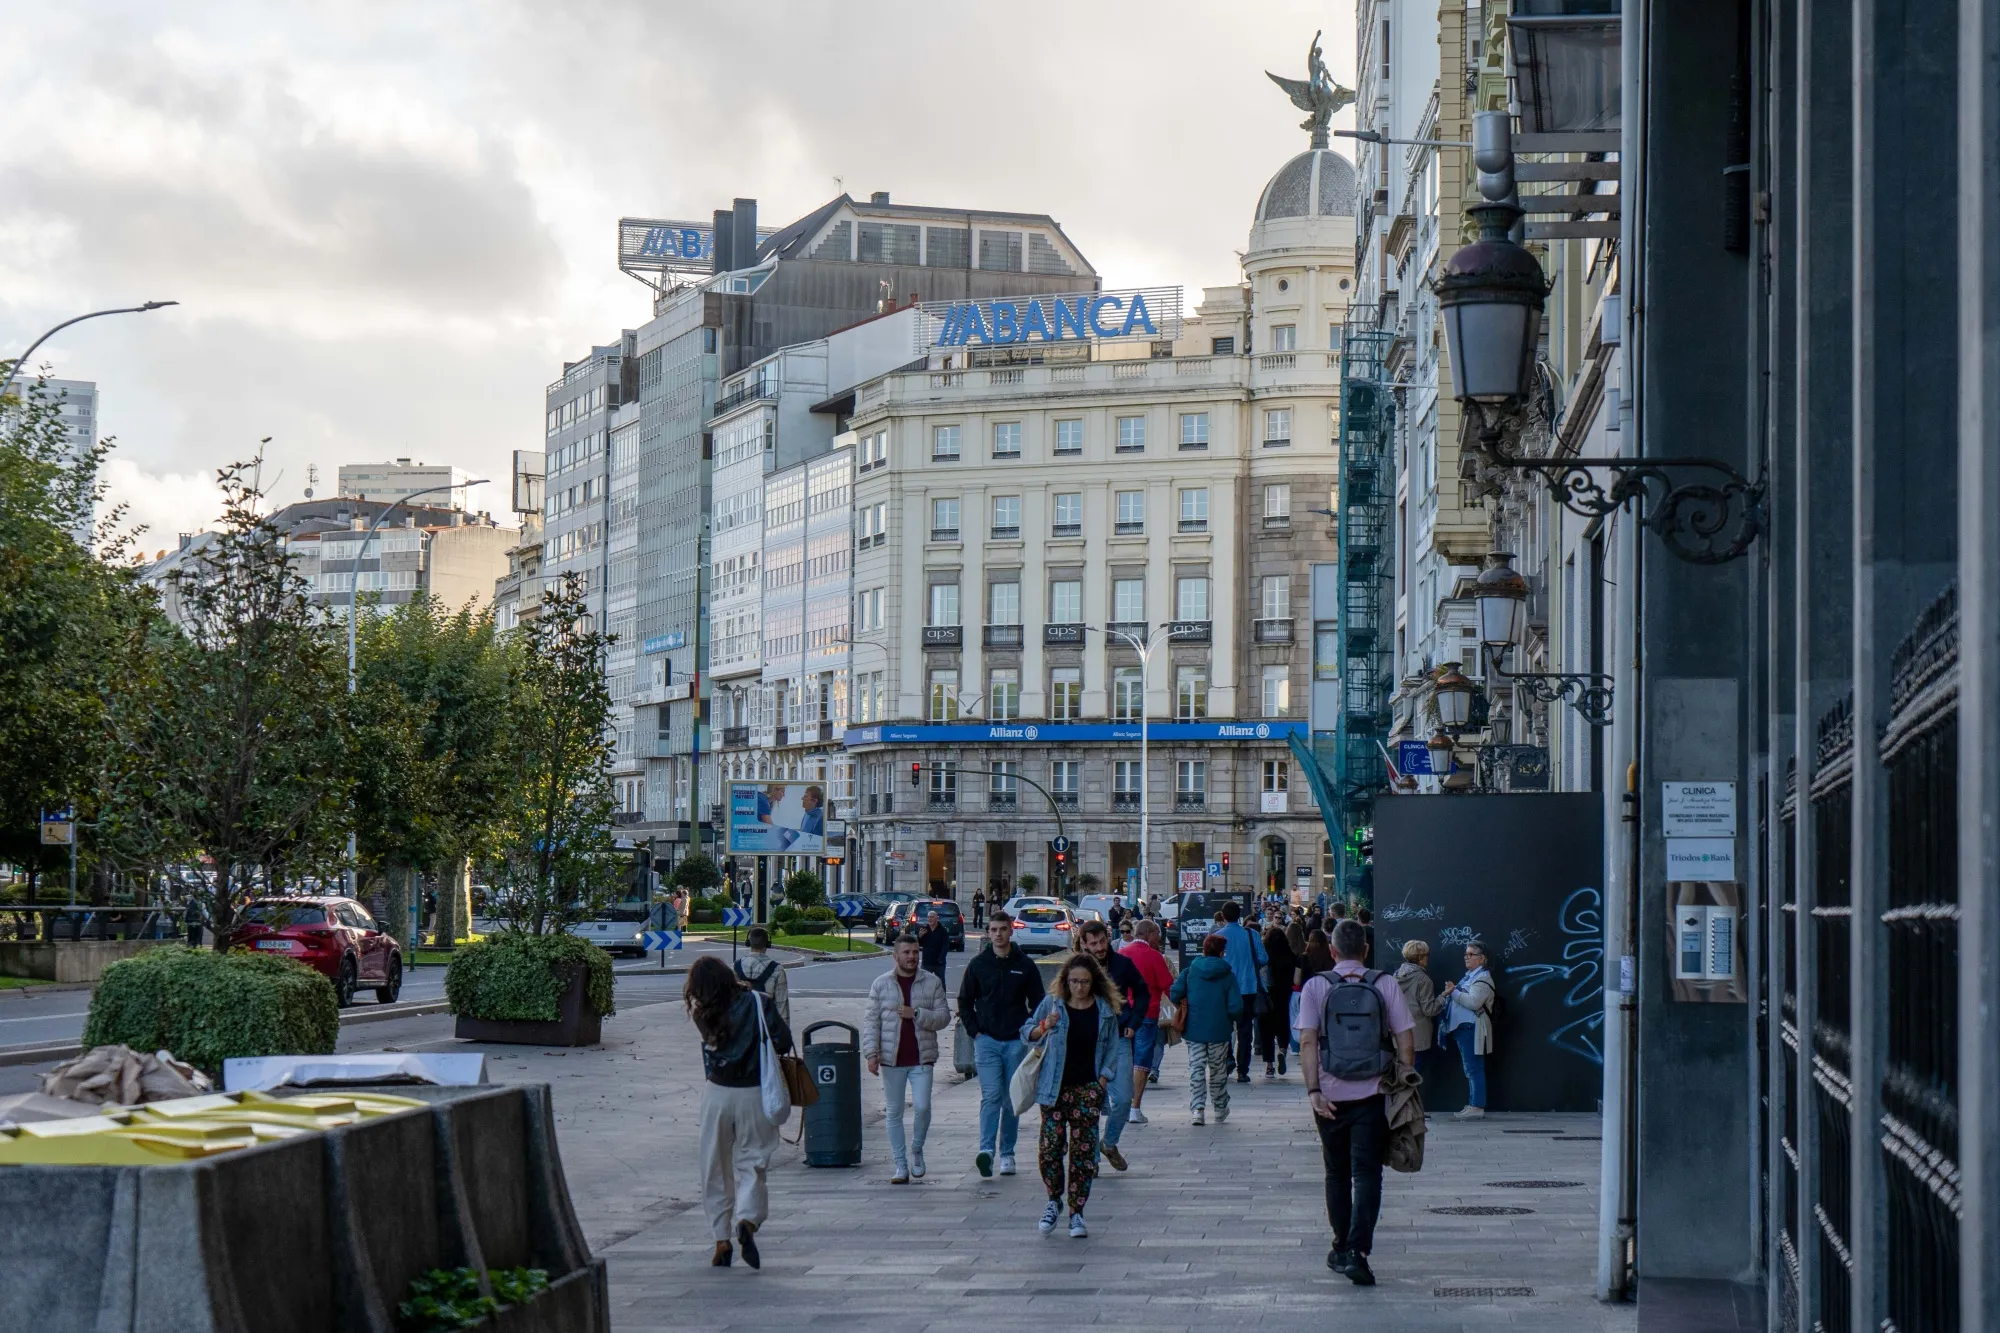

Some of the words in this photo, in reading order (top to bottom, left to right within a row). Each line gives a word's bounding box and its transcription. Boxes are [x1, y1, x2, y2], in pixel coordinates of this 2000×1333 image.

[927, 629, 955, 640] aps
[1048, 626, 1077, 637] aps
[1174, 624, 1204, 635] aps
[989, 727, 1023, 738] Allianz
[1218, 725, 1254, 736] Allianz
[1681, 787, 1717, 795] CLINICA
[1670, 853, 1700, 862] Triodos
[1711, 853, 1731, 862] Bank
[1209, 864, 1218, 875] P
[1183, 881, 1200, 889] KFC
